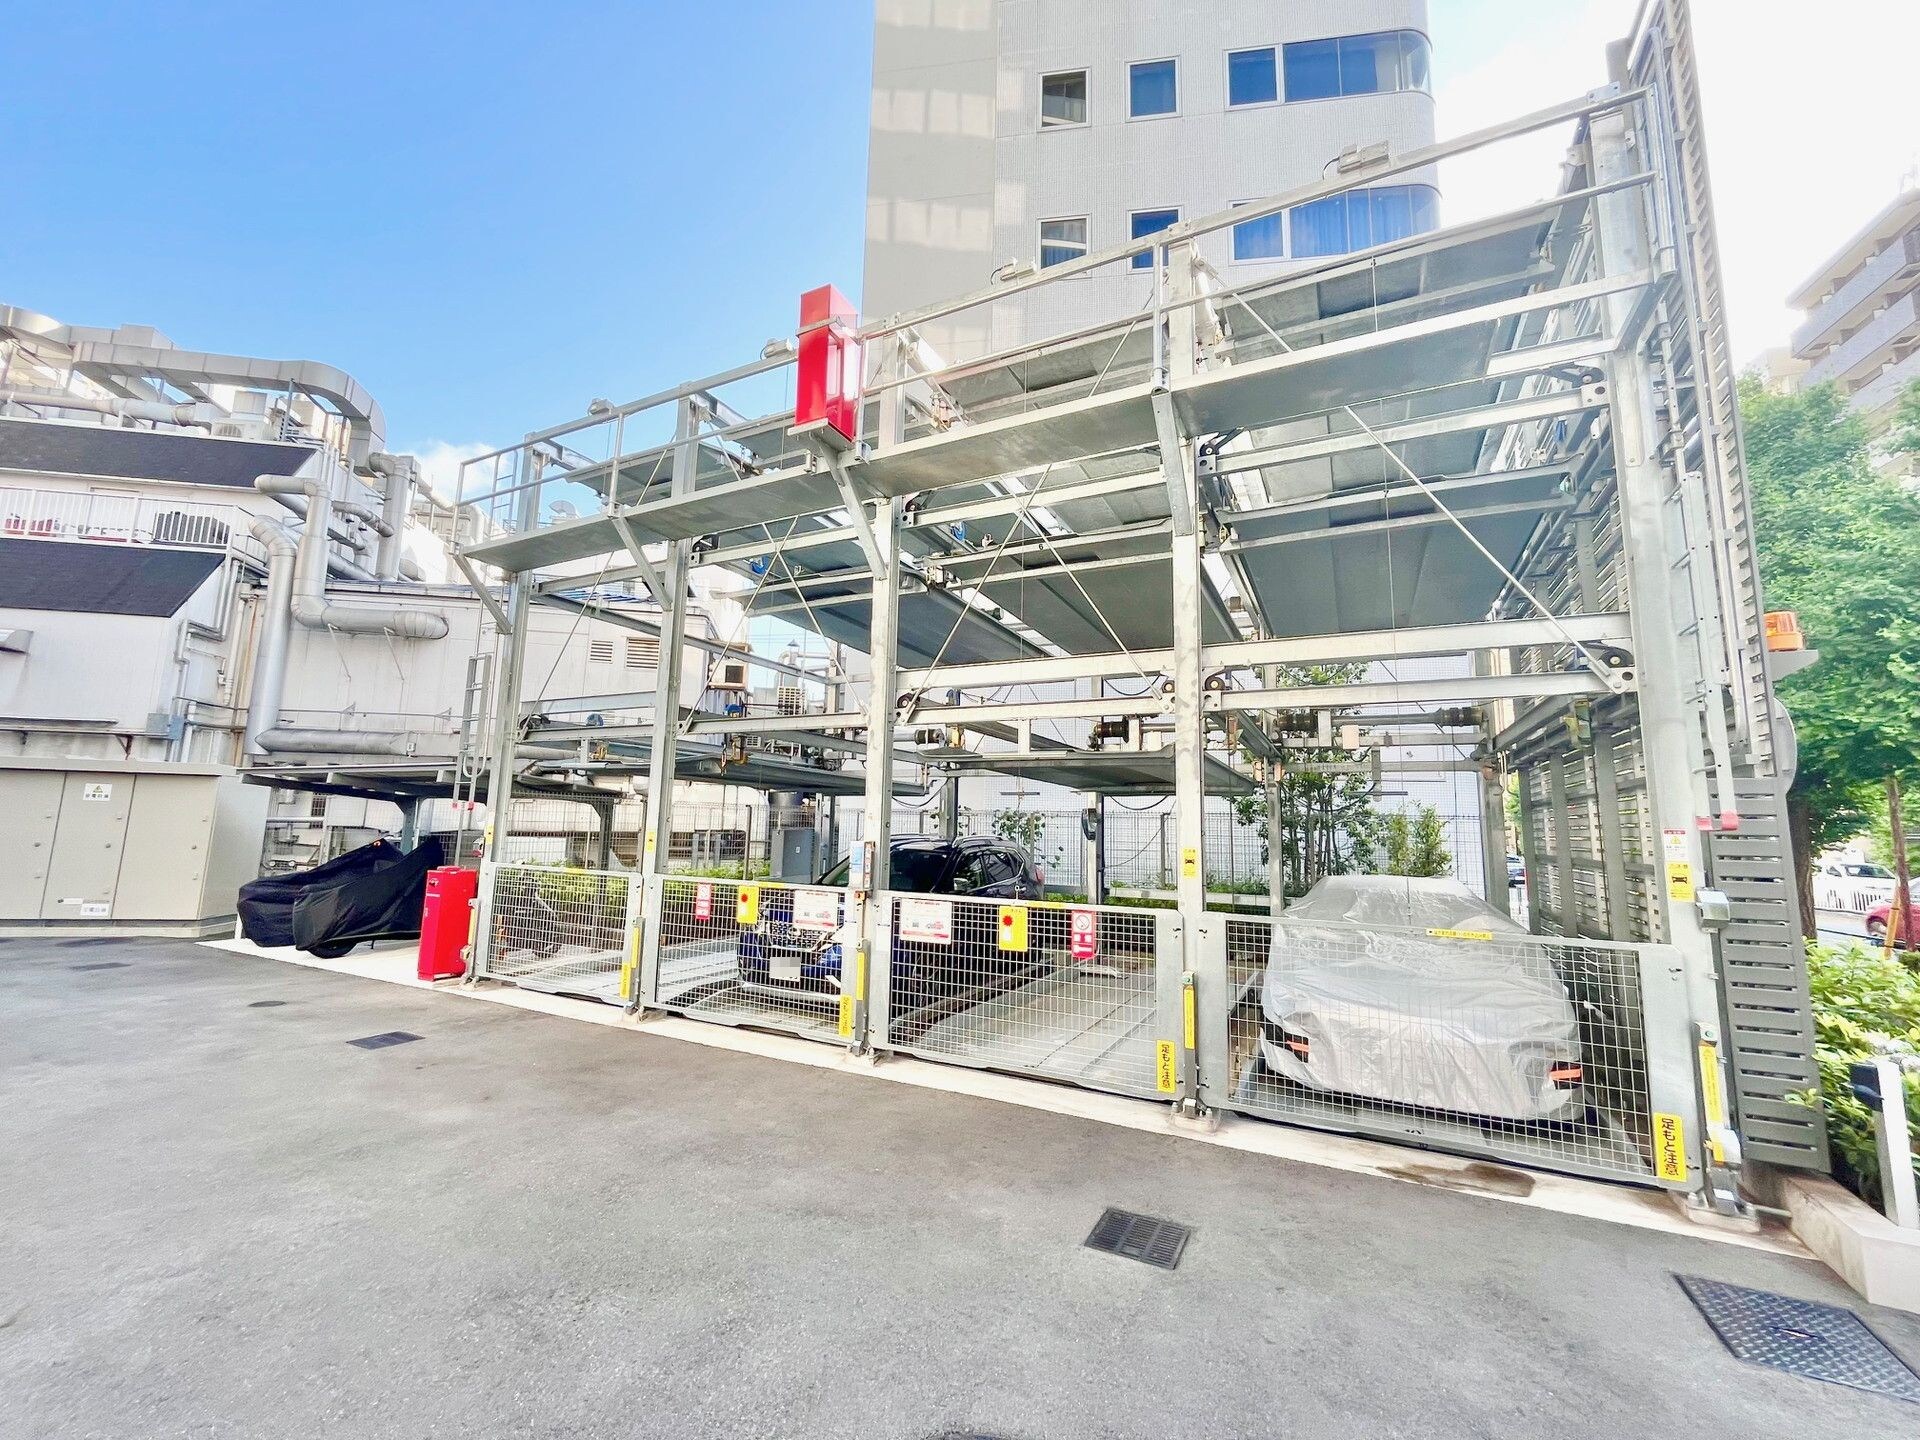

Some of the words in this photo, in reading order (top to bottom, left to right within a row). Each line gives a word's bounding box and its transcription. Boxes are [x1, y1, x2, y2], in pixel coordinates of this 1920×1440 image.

[1161, 1044, 1170, 1088] 足もと注意
[1662, 1118, 1679, 1176] 足もと注意
